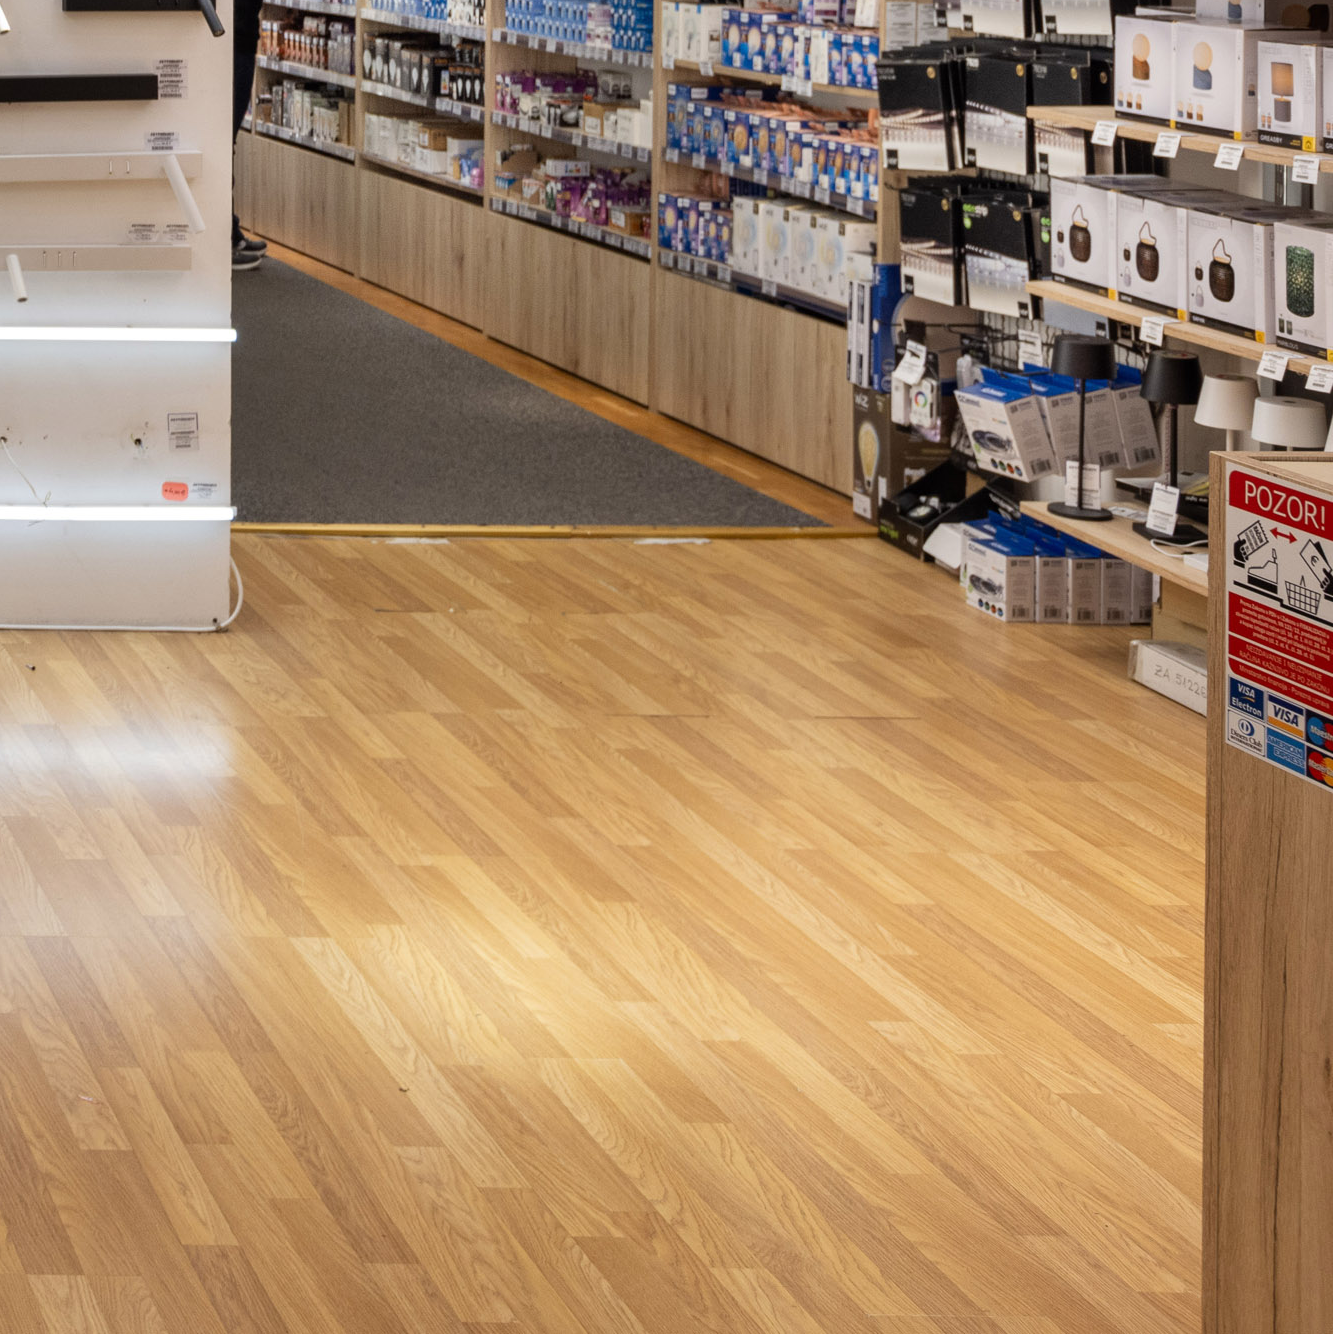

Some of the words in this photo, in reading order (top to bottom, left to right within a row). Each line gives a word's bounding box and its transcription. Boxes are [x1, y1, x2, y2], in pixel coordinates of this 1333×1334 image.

[1244, 480, 1325, 531] POZOR!
[1237, 683, 1255, 698] VISA
[1231, 696, 1262, 717] Electron
[1273, 705, 1299, 727] VISA
